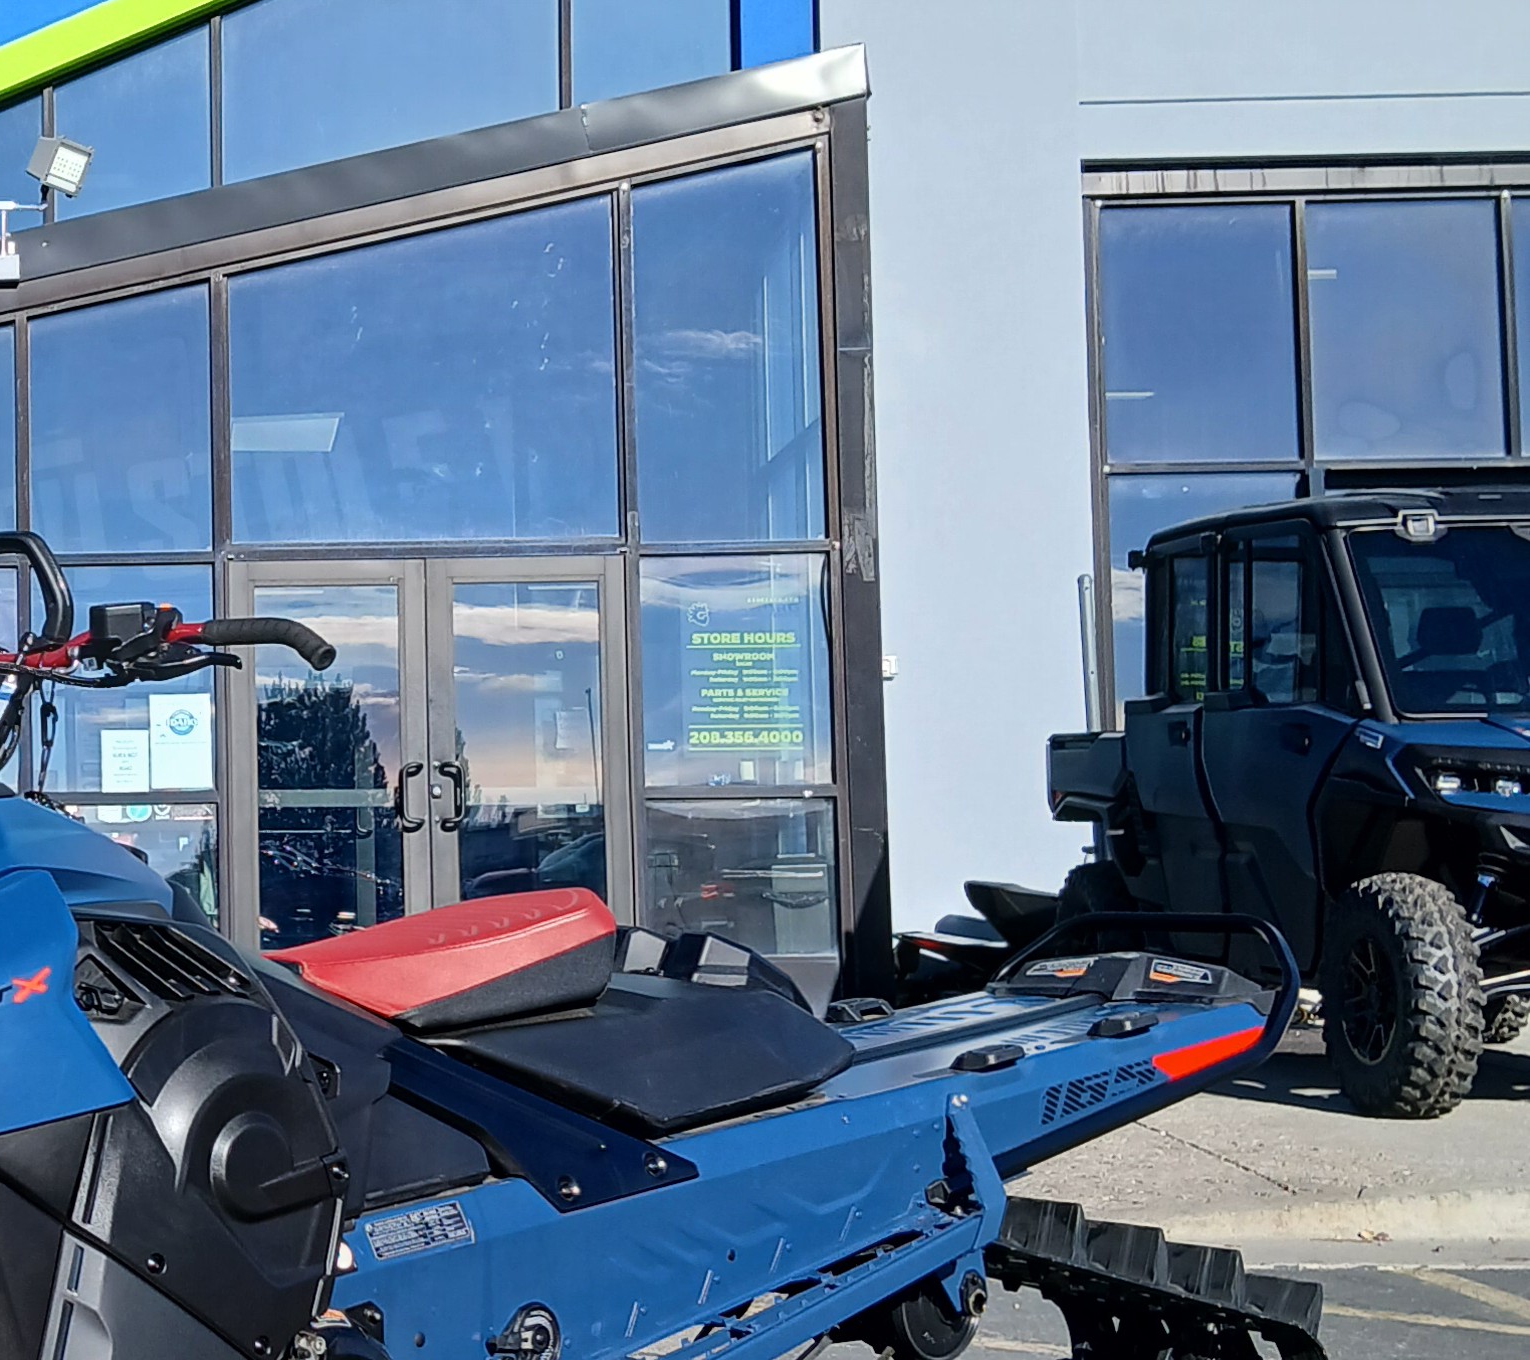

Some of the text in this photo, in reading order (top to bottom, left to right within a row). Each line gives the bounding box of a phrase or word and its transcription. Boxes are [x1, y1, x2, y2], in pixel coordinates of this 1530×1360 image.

[691, 632, 796, 645] STORE HOURS
[689, 731, 803, 745] 208.356.4000
